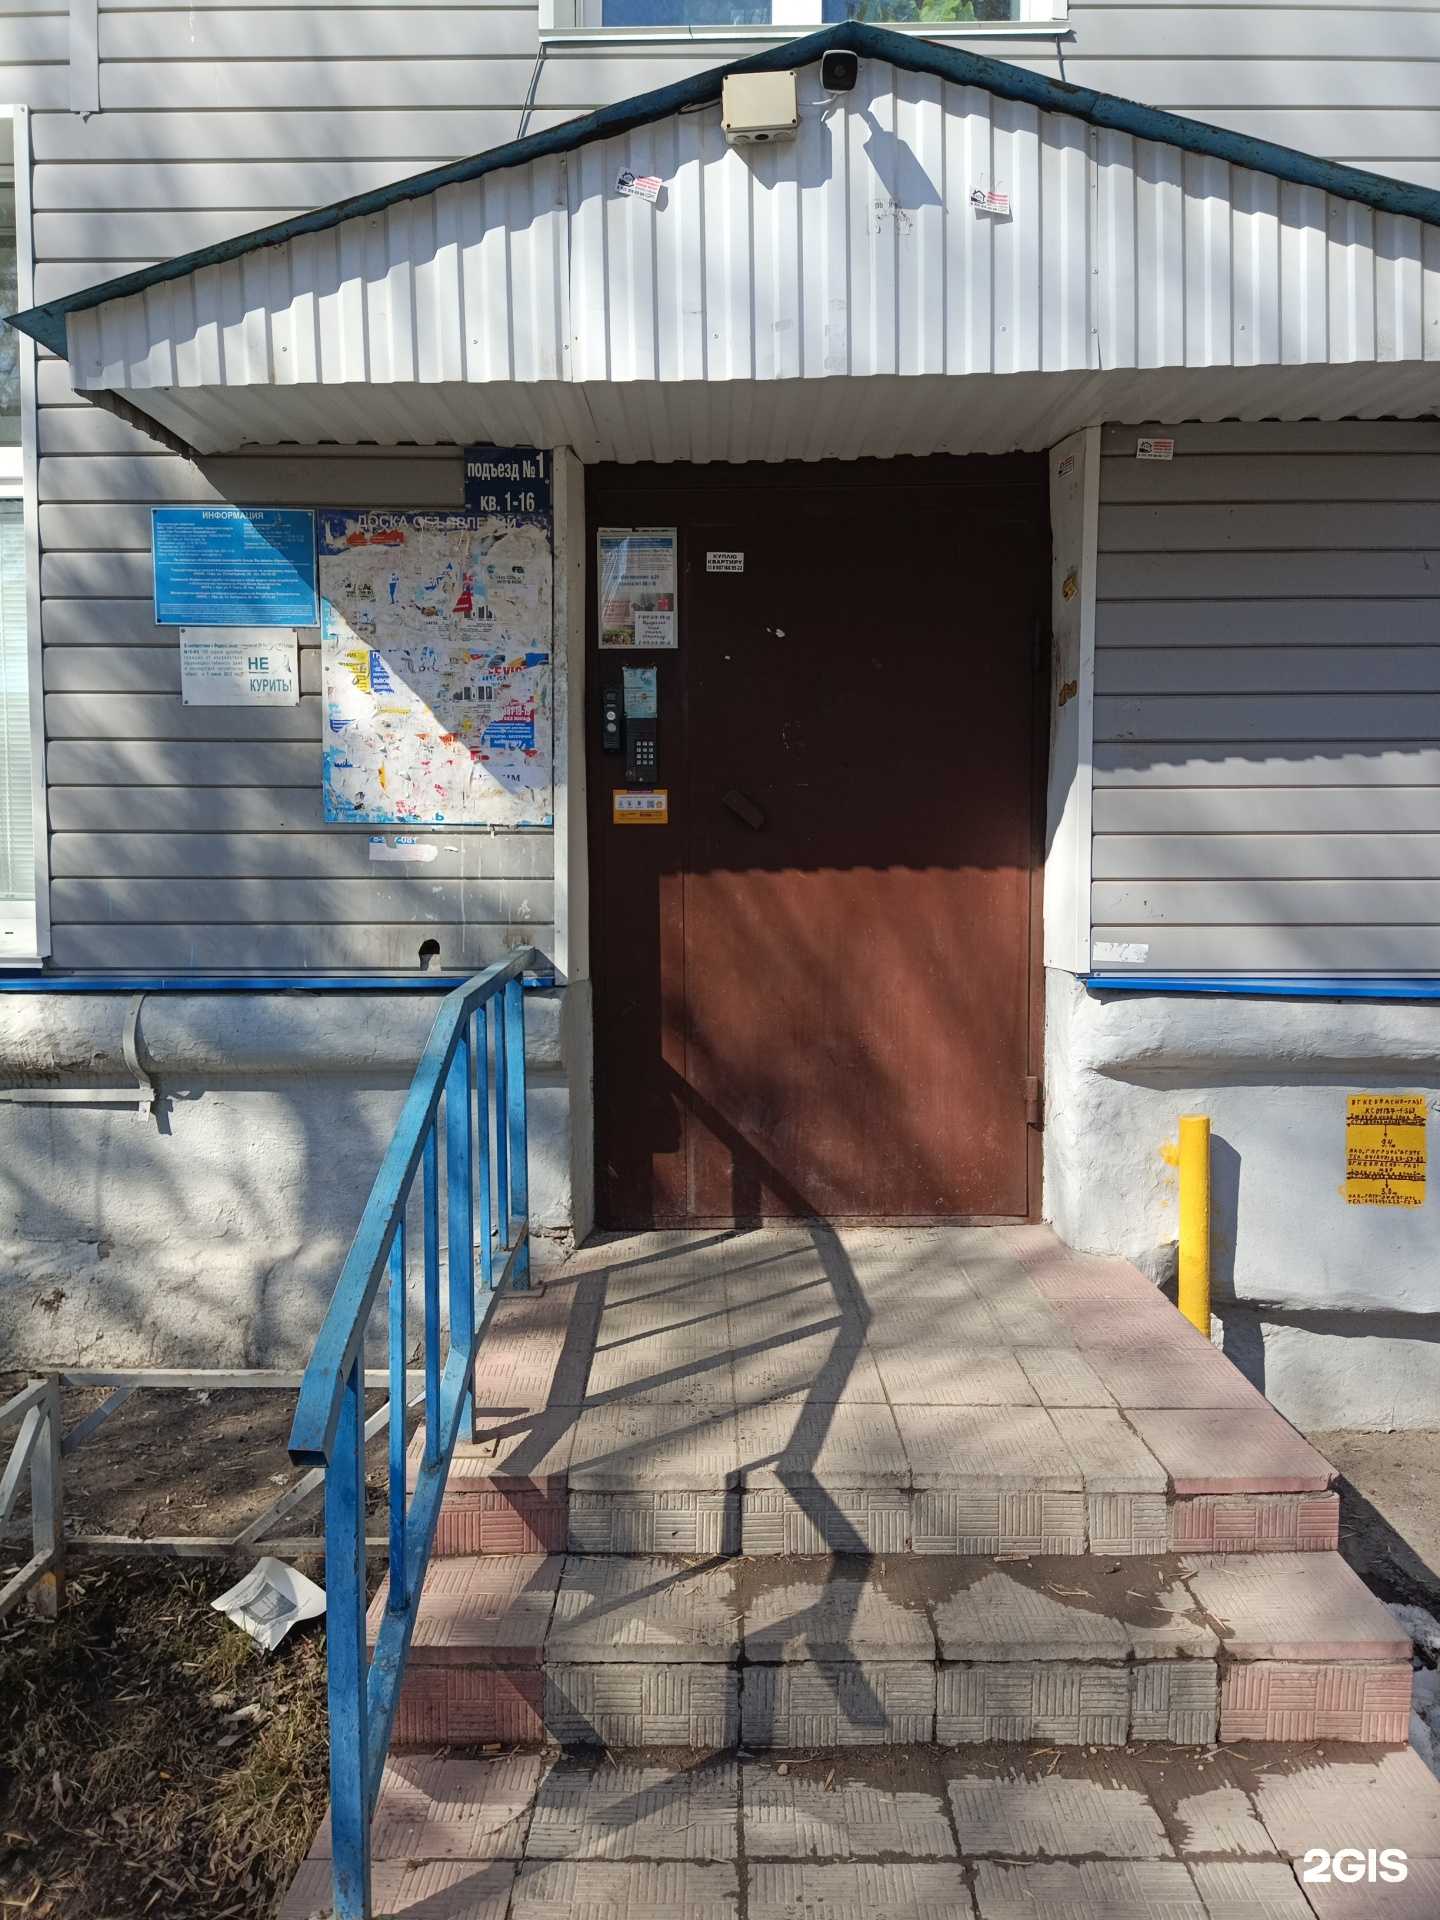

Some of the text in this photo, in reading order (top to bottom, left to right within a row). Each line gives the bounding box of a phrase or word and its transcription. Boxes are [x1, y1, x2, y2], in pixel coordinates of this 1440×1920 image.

[467, 462, 520, 481] подъезд
[504, 491, 535, 512] 1-16
[202, 511, 265, 521] ИНФОРМАЦИЯ
[358, 515, 409, 530] ДОСКА
[248, 656, 270, 671] НЕ
[250, 678, 293, 693] КУРИТЬ!
